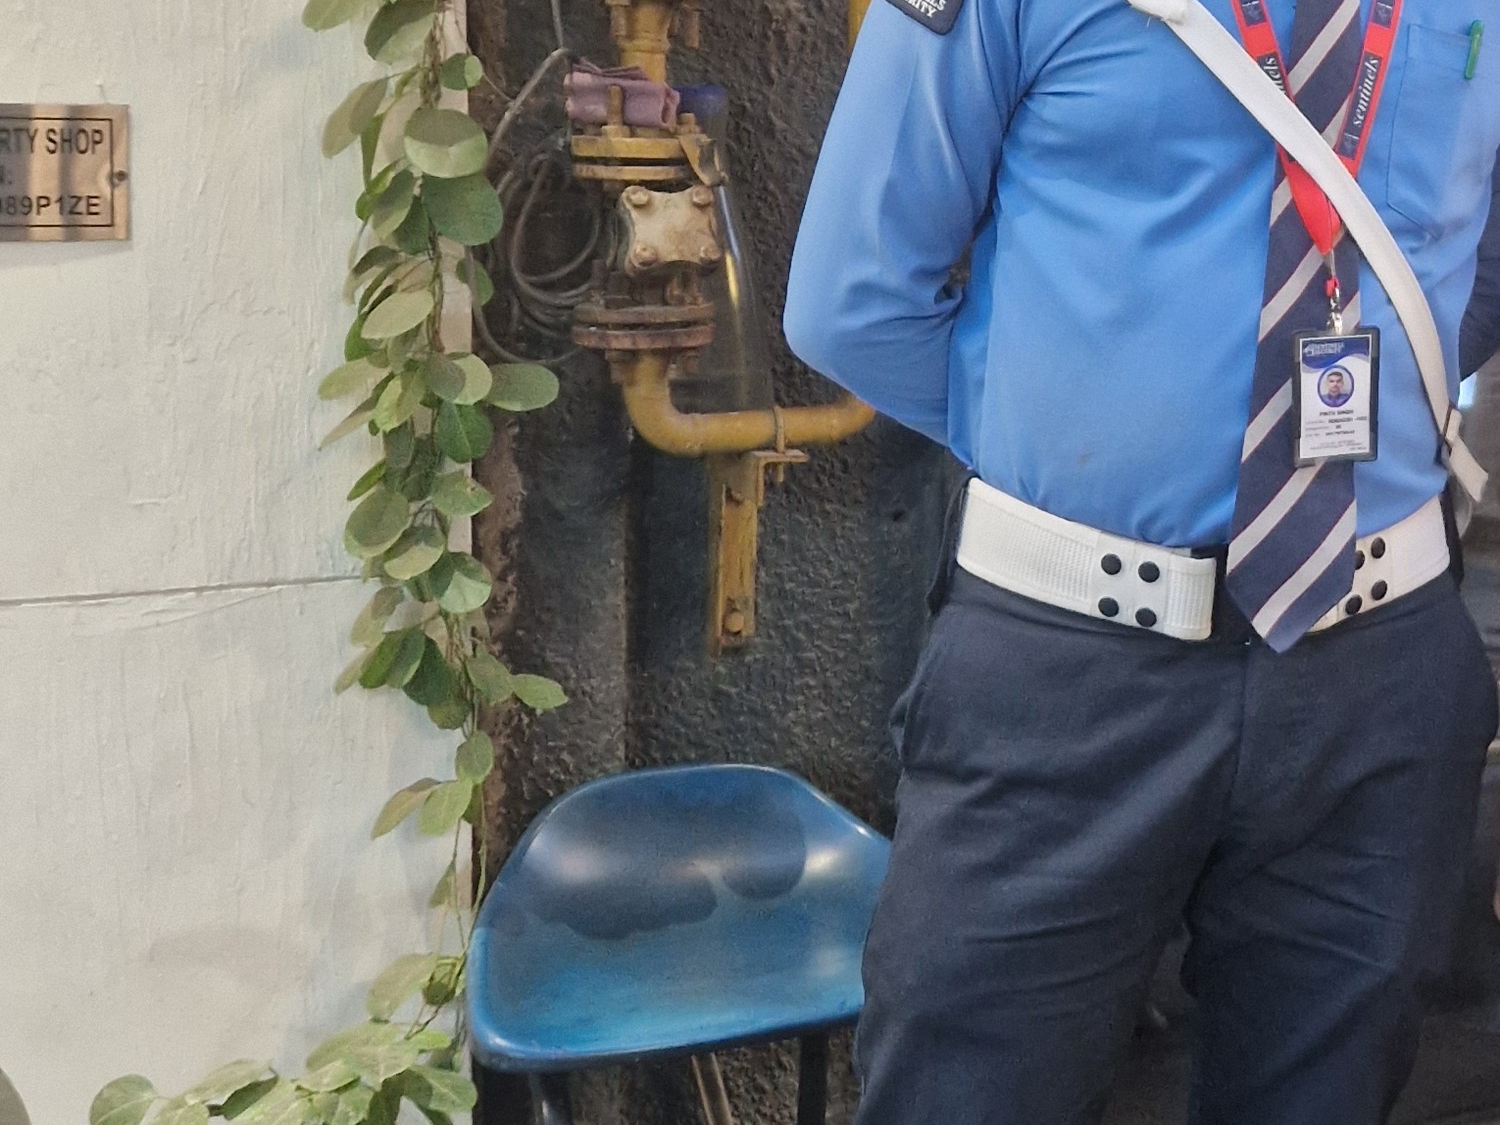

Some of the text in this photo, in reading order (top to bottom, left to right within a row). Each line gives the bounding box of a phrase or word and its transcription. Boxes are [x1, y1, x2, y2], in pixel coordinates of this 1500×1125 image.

[1352, 56, 1380, 127] sentinels
[45, 128, 104, 155] SHOP
[0, 195, 101, 216] 89P1ZE
